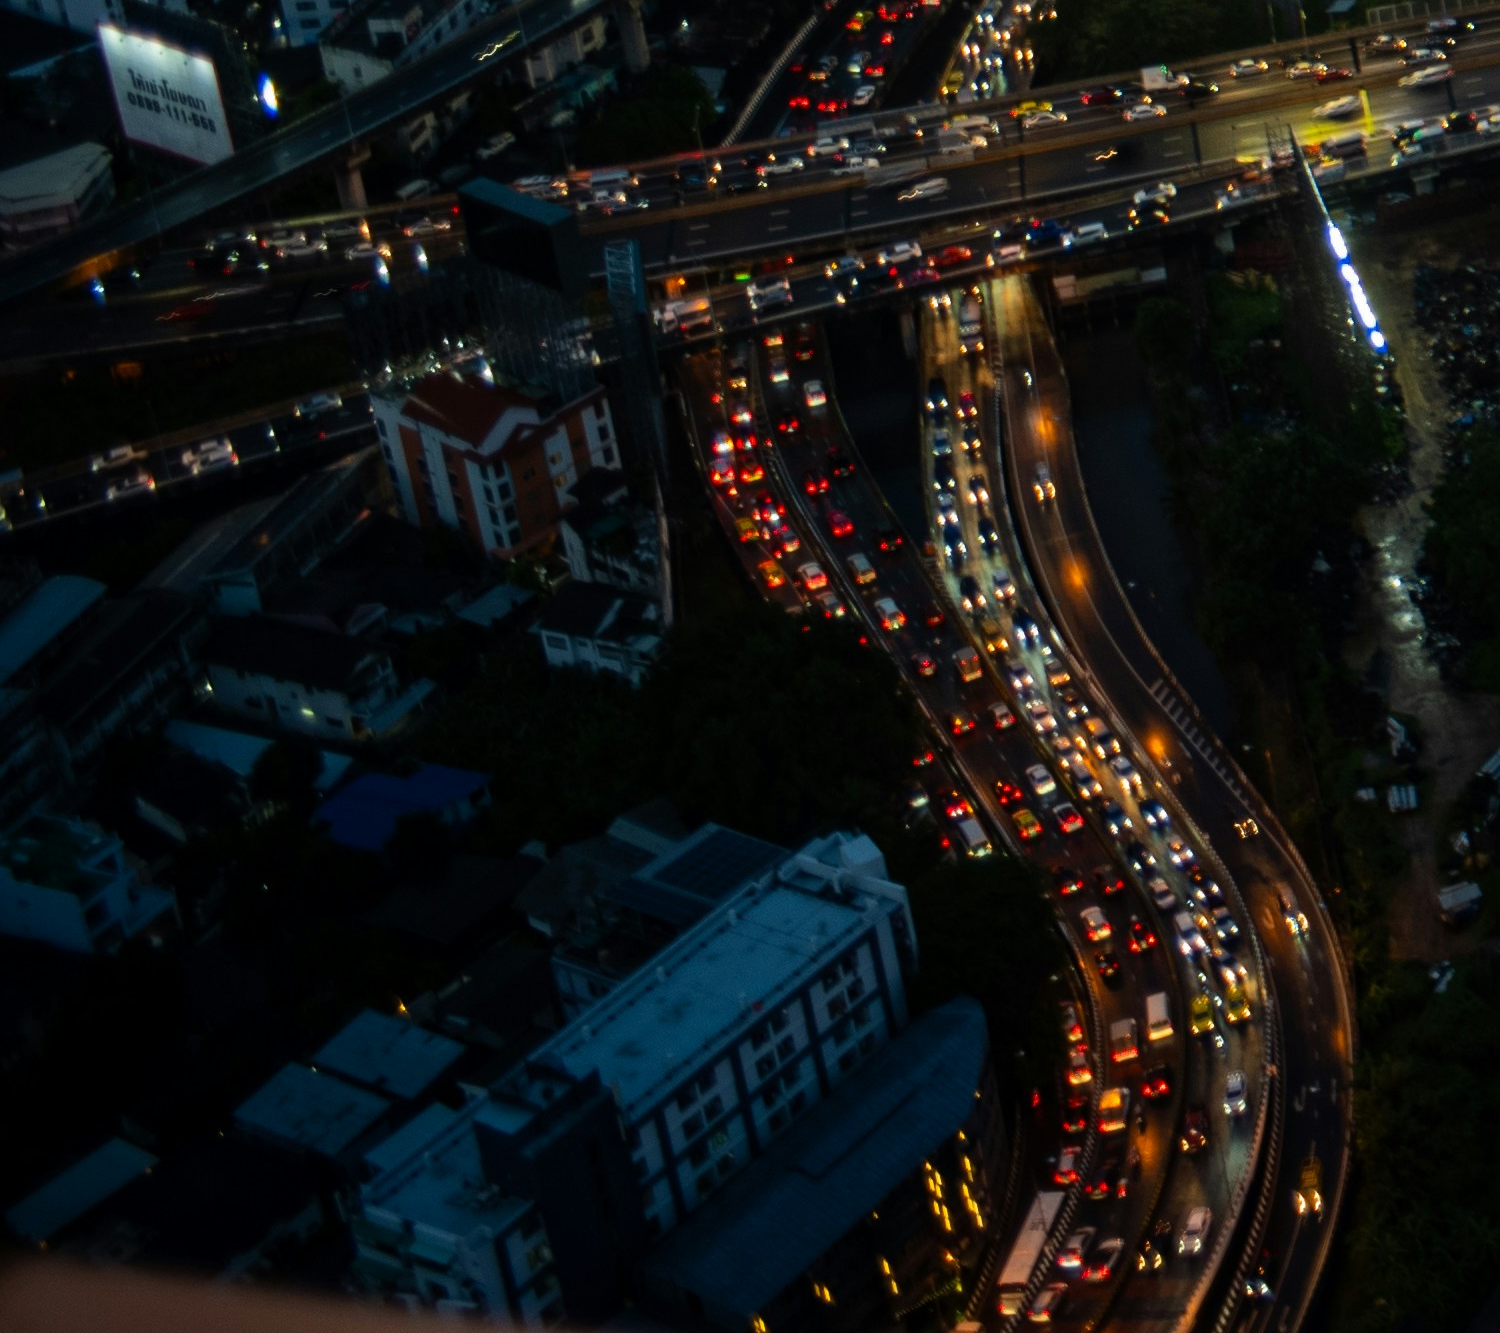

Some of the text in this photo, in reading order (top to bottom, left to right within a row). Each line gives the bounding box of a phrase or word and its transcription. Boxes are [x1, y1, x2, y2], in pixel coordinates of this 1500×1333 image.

[127, 68, 208, 113] ให้เช่าโฆษณา
